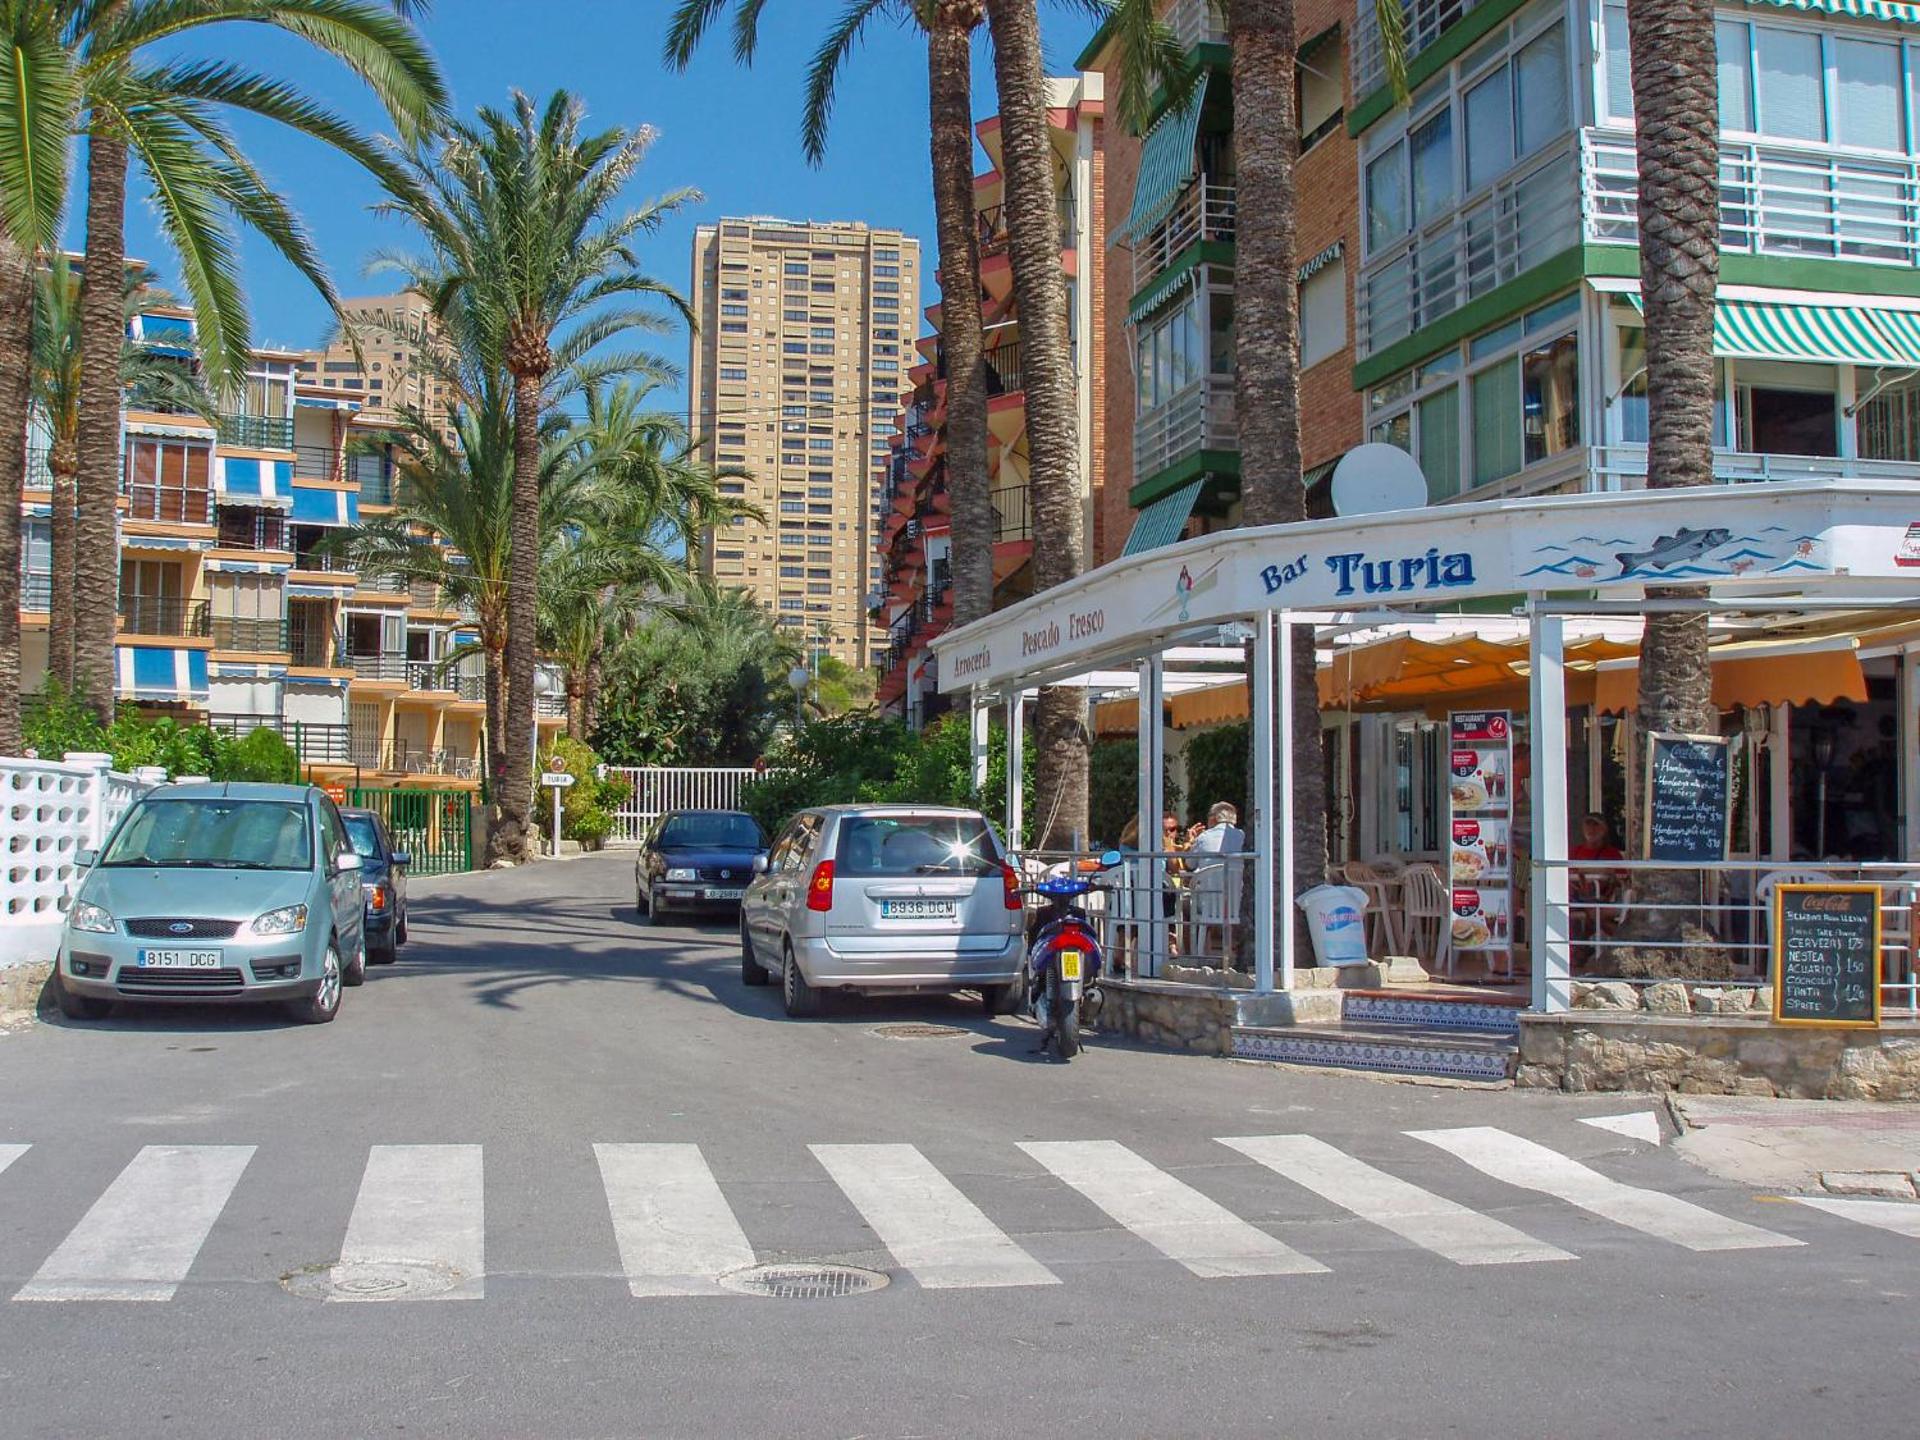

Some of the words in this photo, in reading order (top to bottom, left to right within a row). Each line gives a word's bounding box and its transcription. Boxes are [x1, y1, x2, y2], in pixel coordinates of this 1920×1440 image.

[1259, 553, 1308, 595] Bar
[1324, 547, 1476, 597] Turia
[1022, 619, 1060, 657] Pescado
[1069, 608, 1105, 641] Fresco
[953, 644, 992, 677] Arrocería
[890, 901, 924, 914] 8936
[928, 901, 953, 914] DCM
[147, 951, 179, 967] 8151
[190, 952, 215, 967] DCG
[1788, 950, 1825, 962] NESTEA
